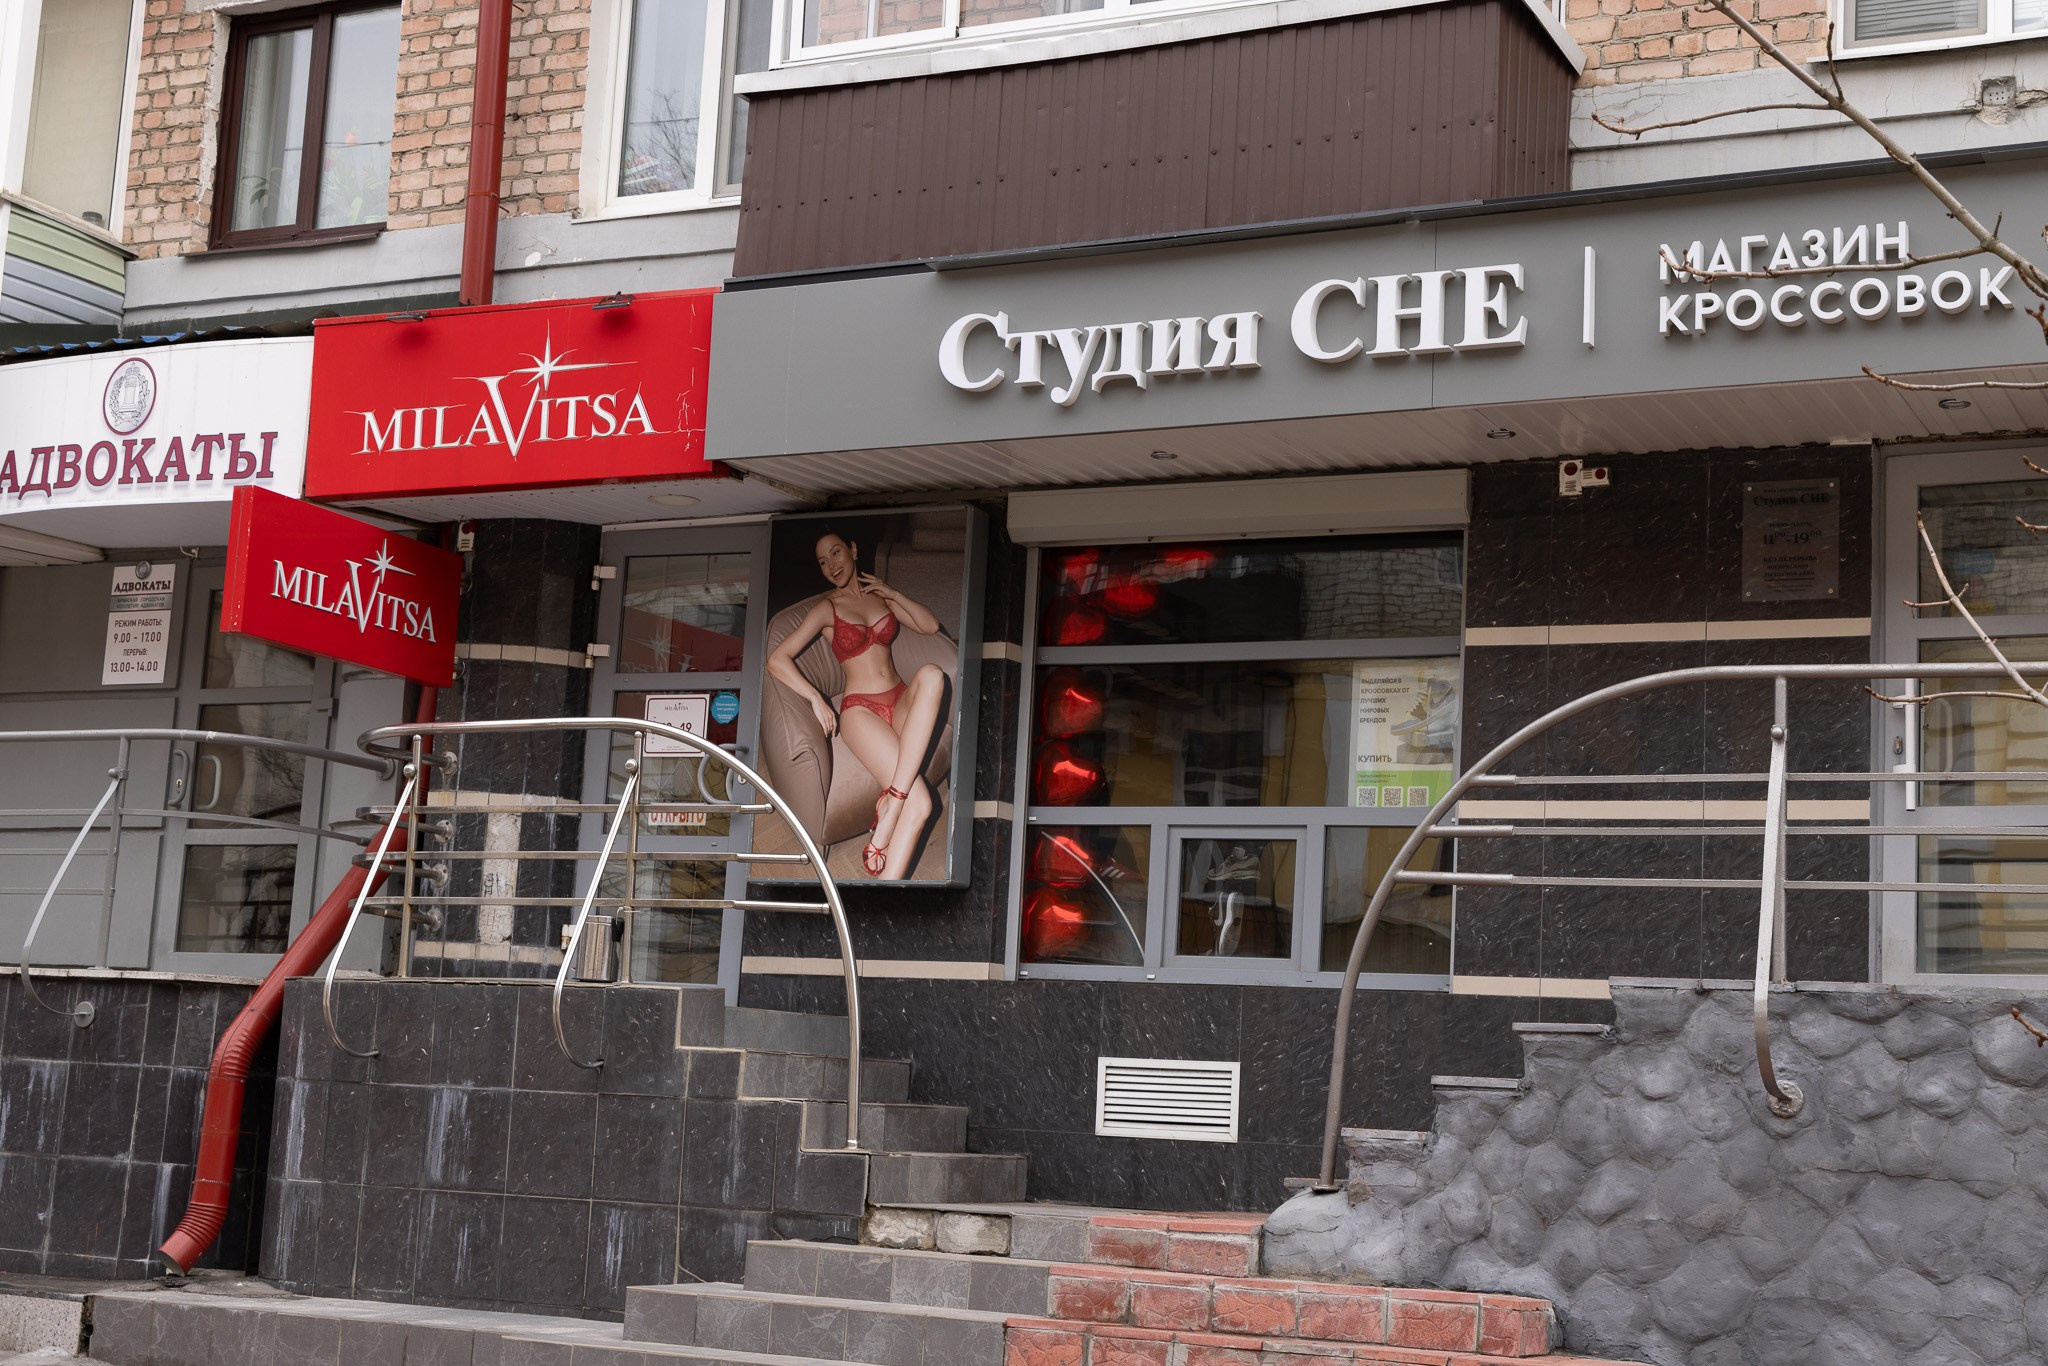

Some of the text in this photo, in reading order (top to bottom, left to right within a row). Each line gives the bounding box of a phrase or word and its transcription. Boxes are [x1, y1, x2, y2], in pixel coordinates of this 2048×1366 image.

[1659, 220, 1911, 285] МАГАЗИН
[1659, 265, 2015, 337] КРОССОВОК
[938, 263, 1528, 407] Студия СНЕ
[348, 375, 662, 460] MILAVITSA
[0, 431, 279, 500] АДВОКАТЫ
[114, 580, 171, 593] АДВОКАТЫ
[270, 560, 437, 643] MILAVITSA
[113, 632, 131, 643] 9.00
[141, 632, 161, 642] 17.00
[123, 648, 148, 656] ПЕРЕРЫВ:
[1357, 754, 1393, 763] КУПИТЬ
